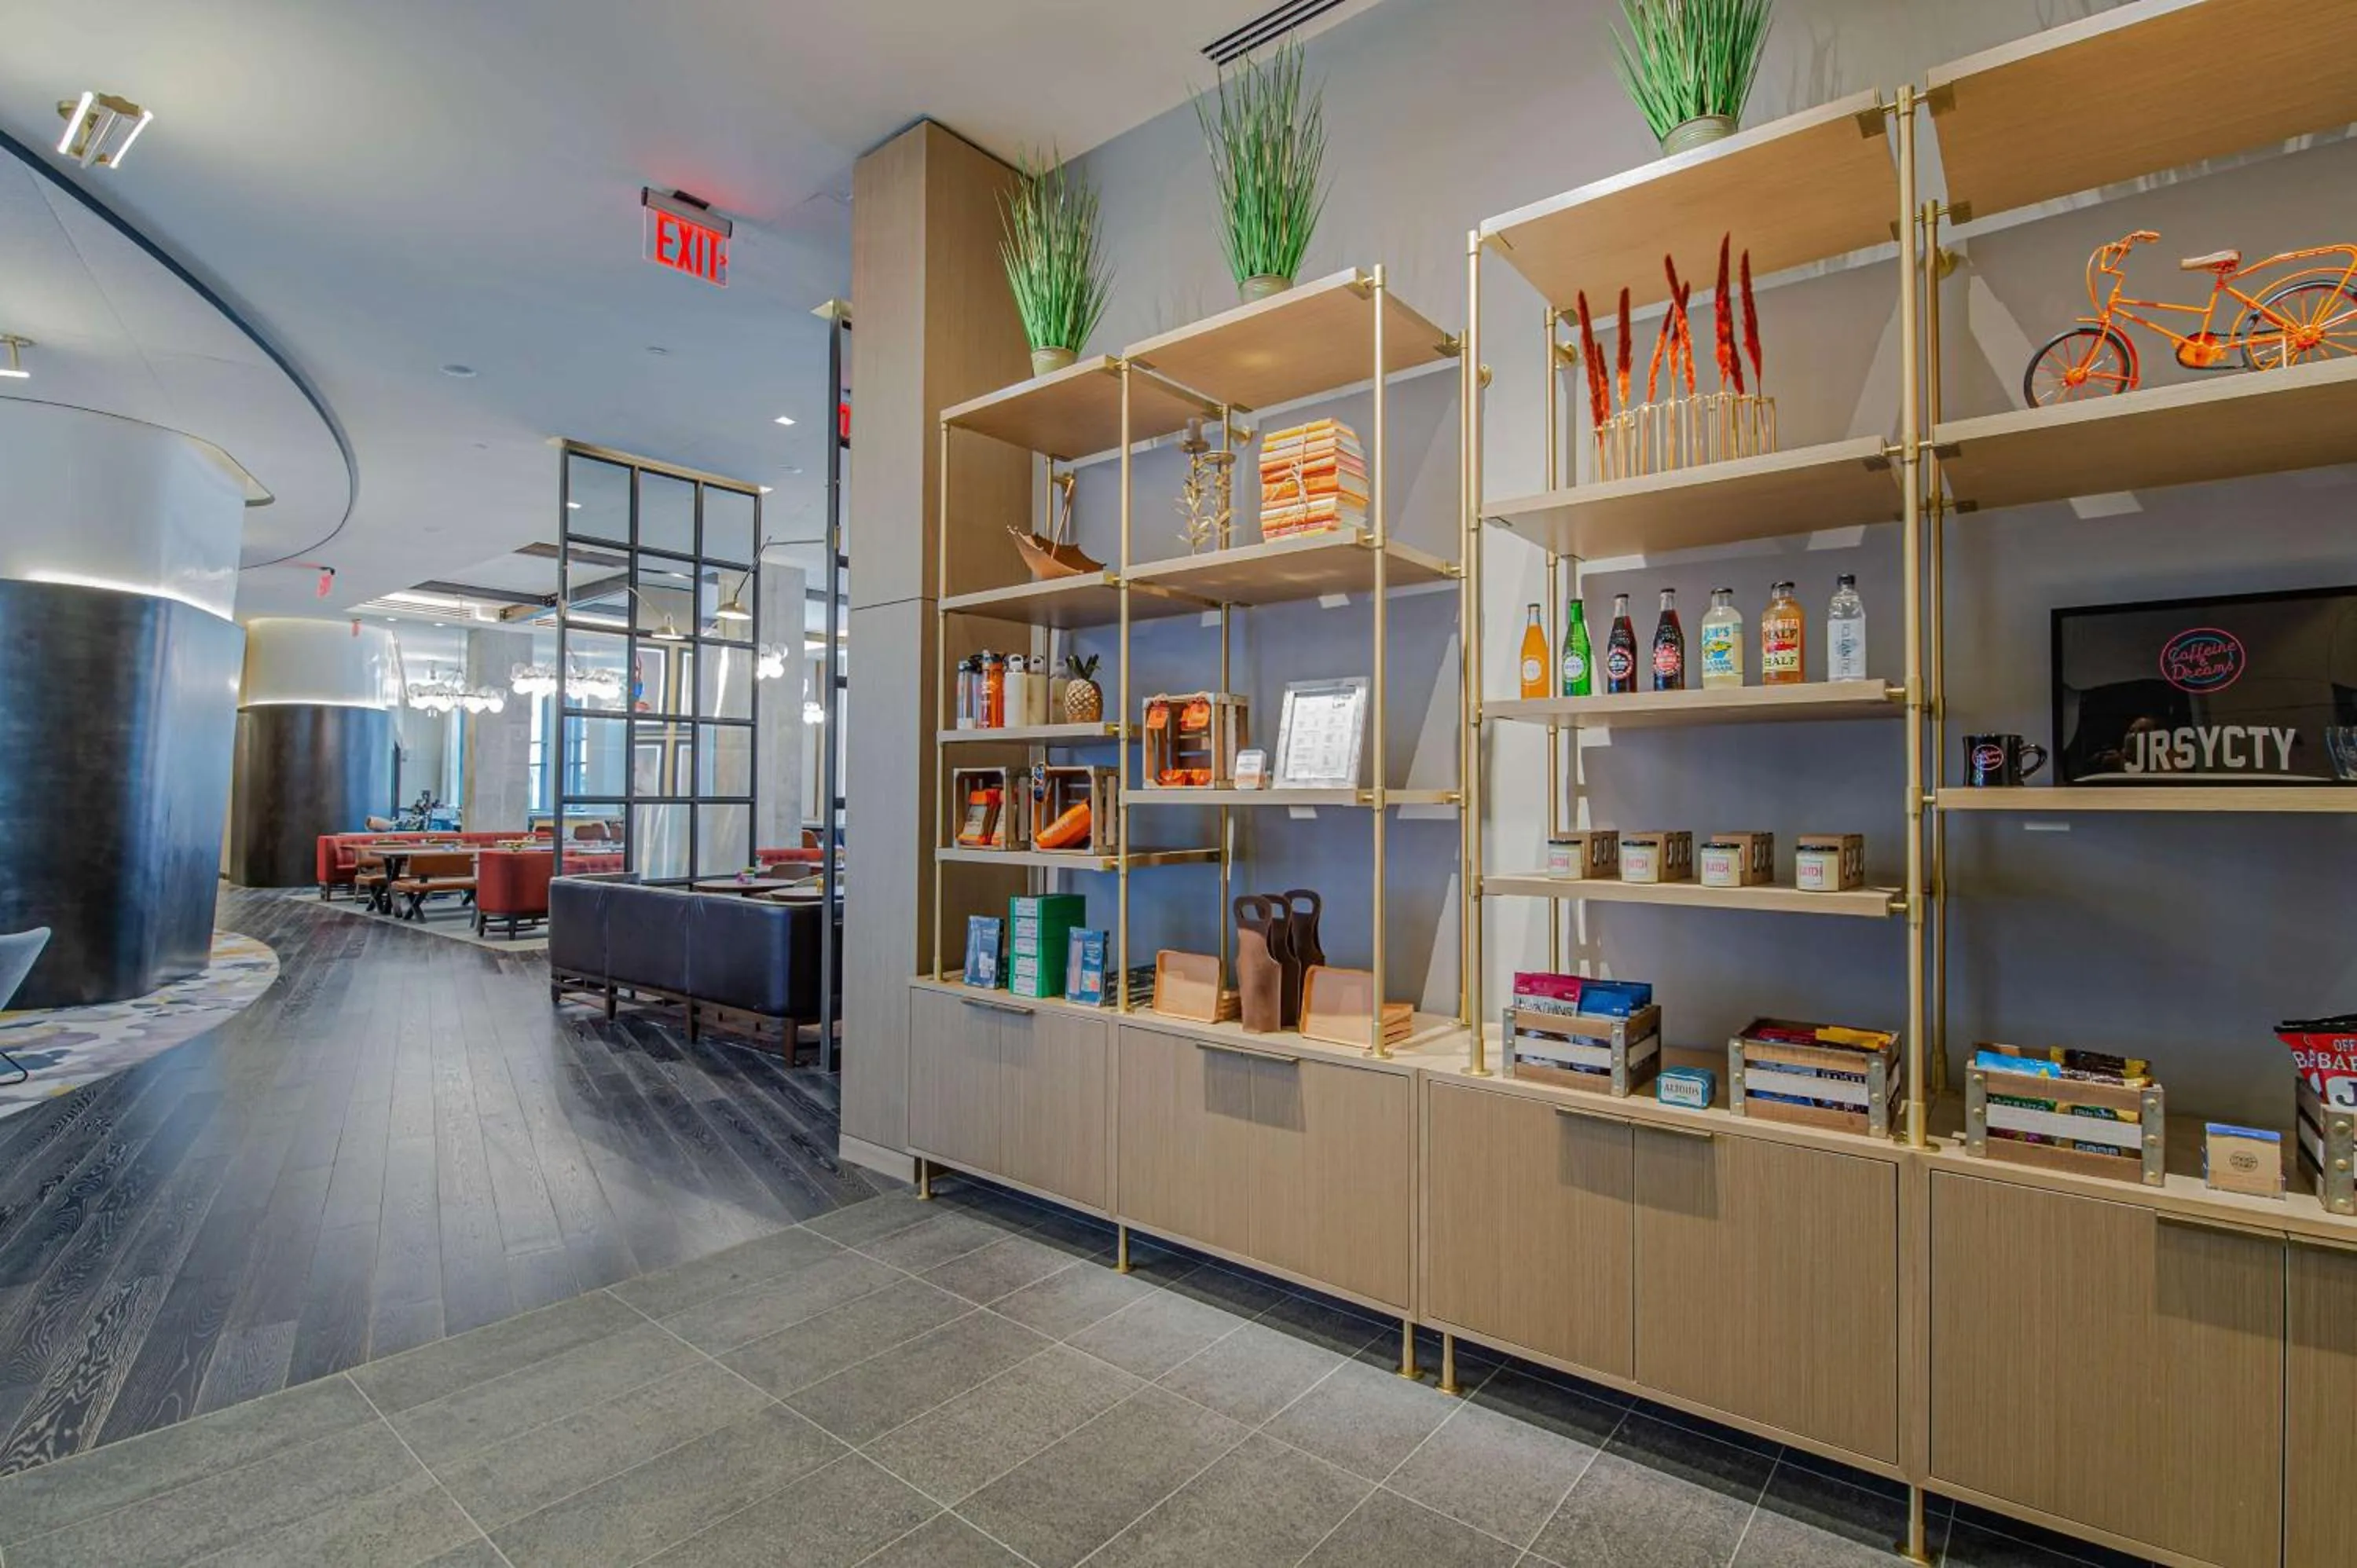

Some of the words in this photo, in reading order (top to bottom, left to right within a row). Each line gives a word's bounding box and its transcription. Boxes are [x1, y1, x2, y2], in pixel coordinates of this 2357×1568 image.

[655, 209, 723, 281] EXIT
[1765, 656, 1797, 667] HALF
[2168, 643, 2236, 663] Caffeine
[2172, 663, 2234, 680] Dreams
[2124, 725, 2296, 773] JRSYCTY
